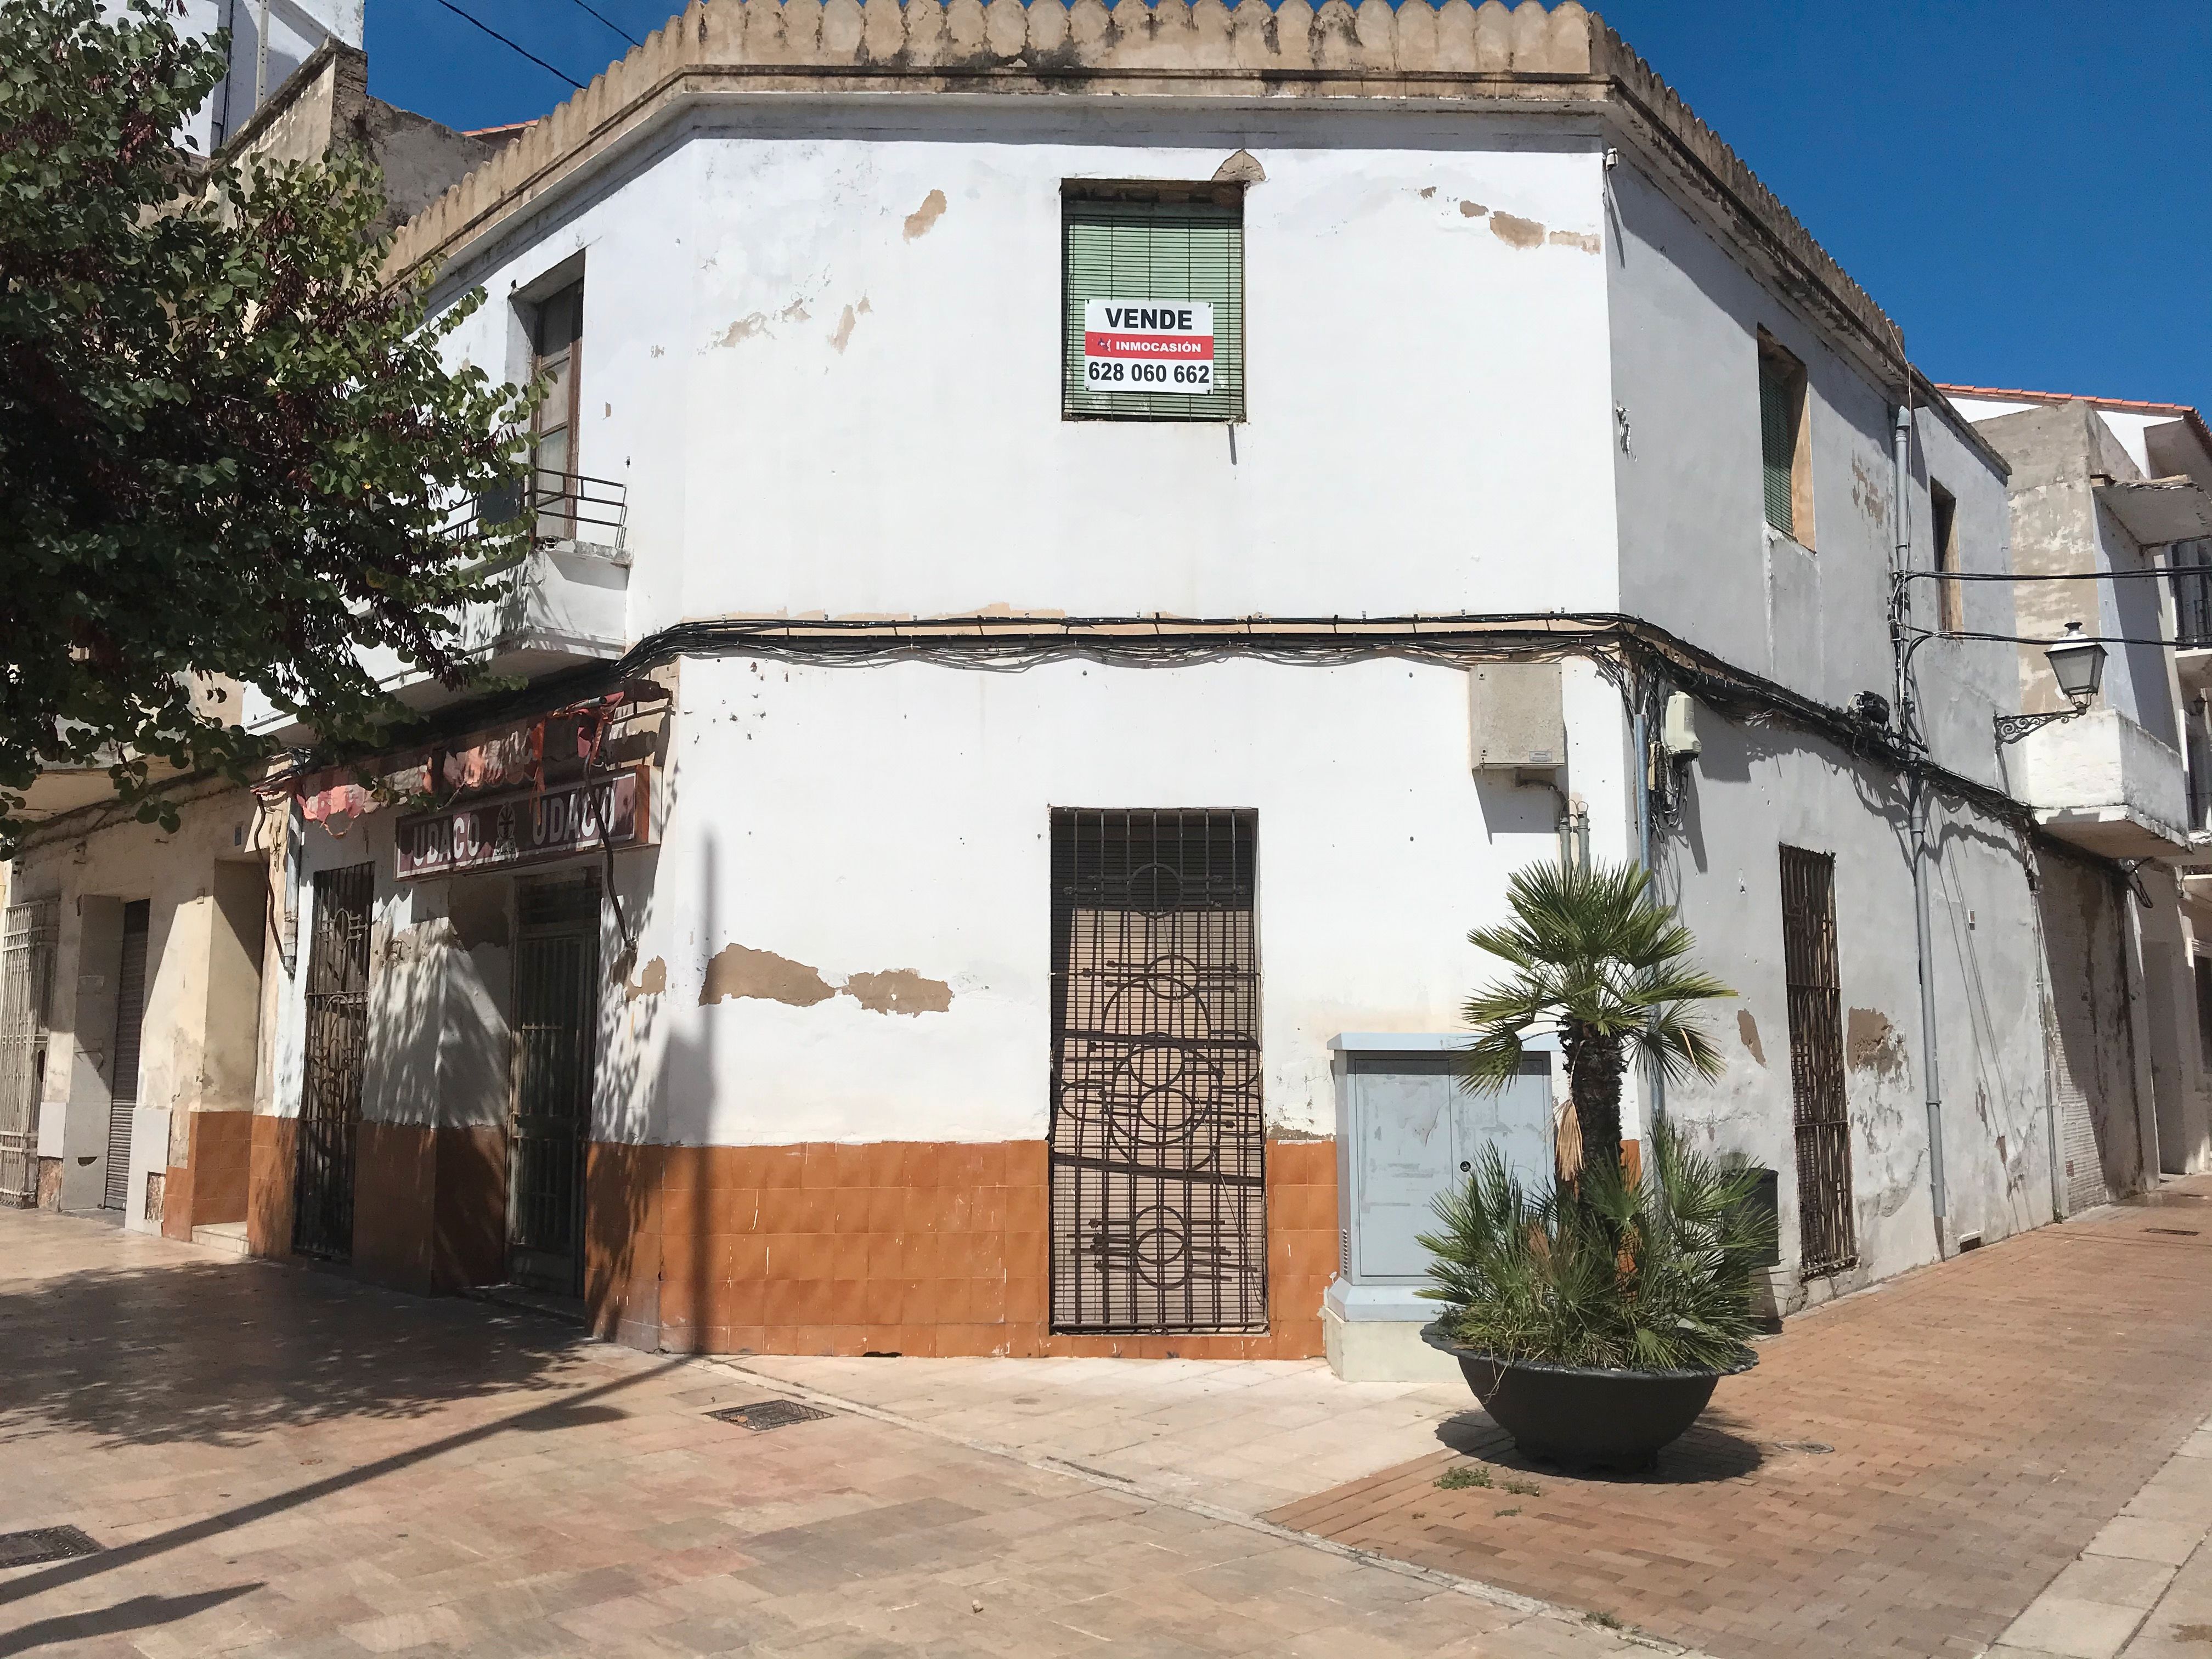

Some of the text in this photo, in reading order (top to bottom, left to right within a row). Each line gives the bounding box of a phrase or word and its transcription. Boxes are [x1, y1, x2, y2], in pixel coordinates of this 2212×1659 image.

[1105, 308, 1192, 329] VENDE
[1116, 341, 1201, 352] INMOCASIÓN
[1088, 362, 1209, 383] 628 060 662
[413, 786, 615, 866] UDACO UDACO
